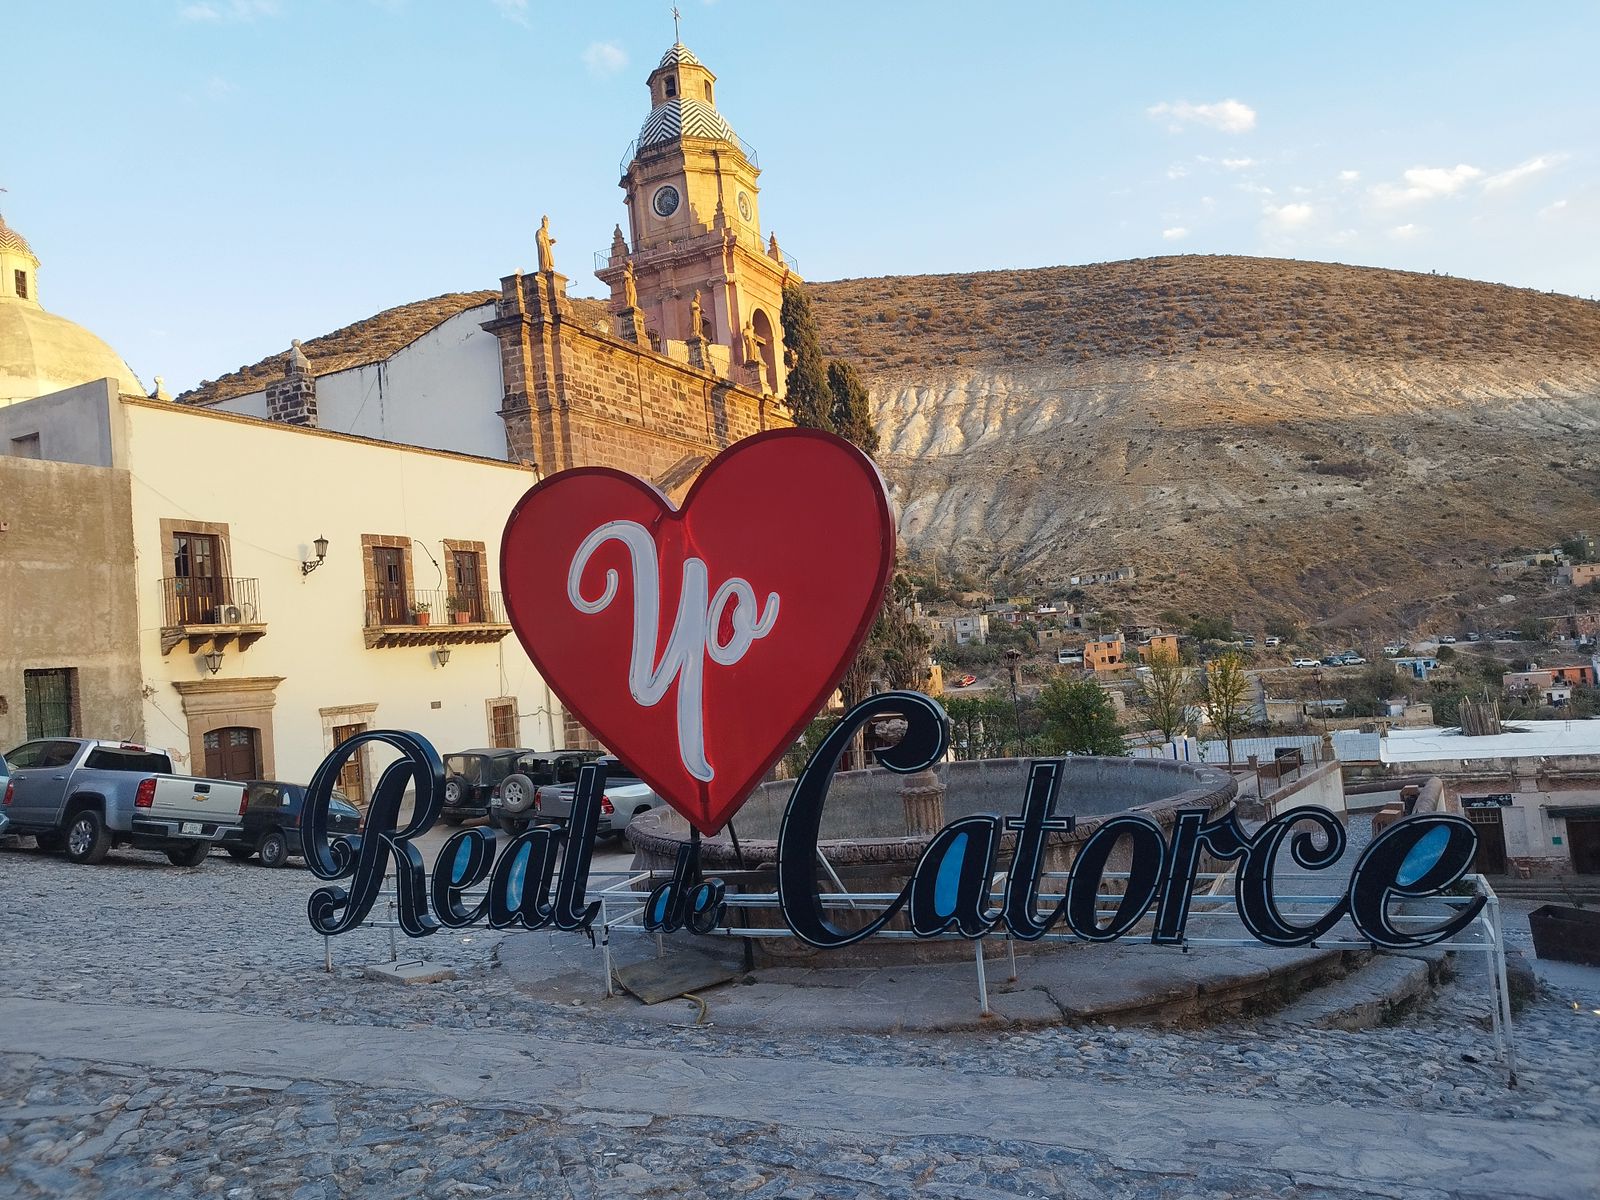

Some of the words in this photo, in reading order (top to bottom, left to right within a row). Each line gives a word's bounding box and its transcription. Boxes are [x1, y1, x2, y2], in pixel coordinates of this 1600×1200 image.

[567, 520, 781, 783] Yo
[301, 729, 603, 938] Real
[643, 842, 728, 935] de
[778, 690, 1487, 949] Catorce
